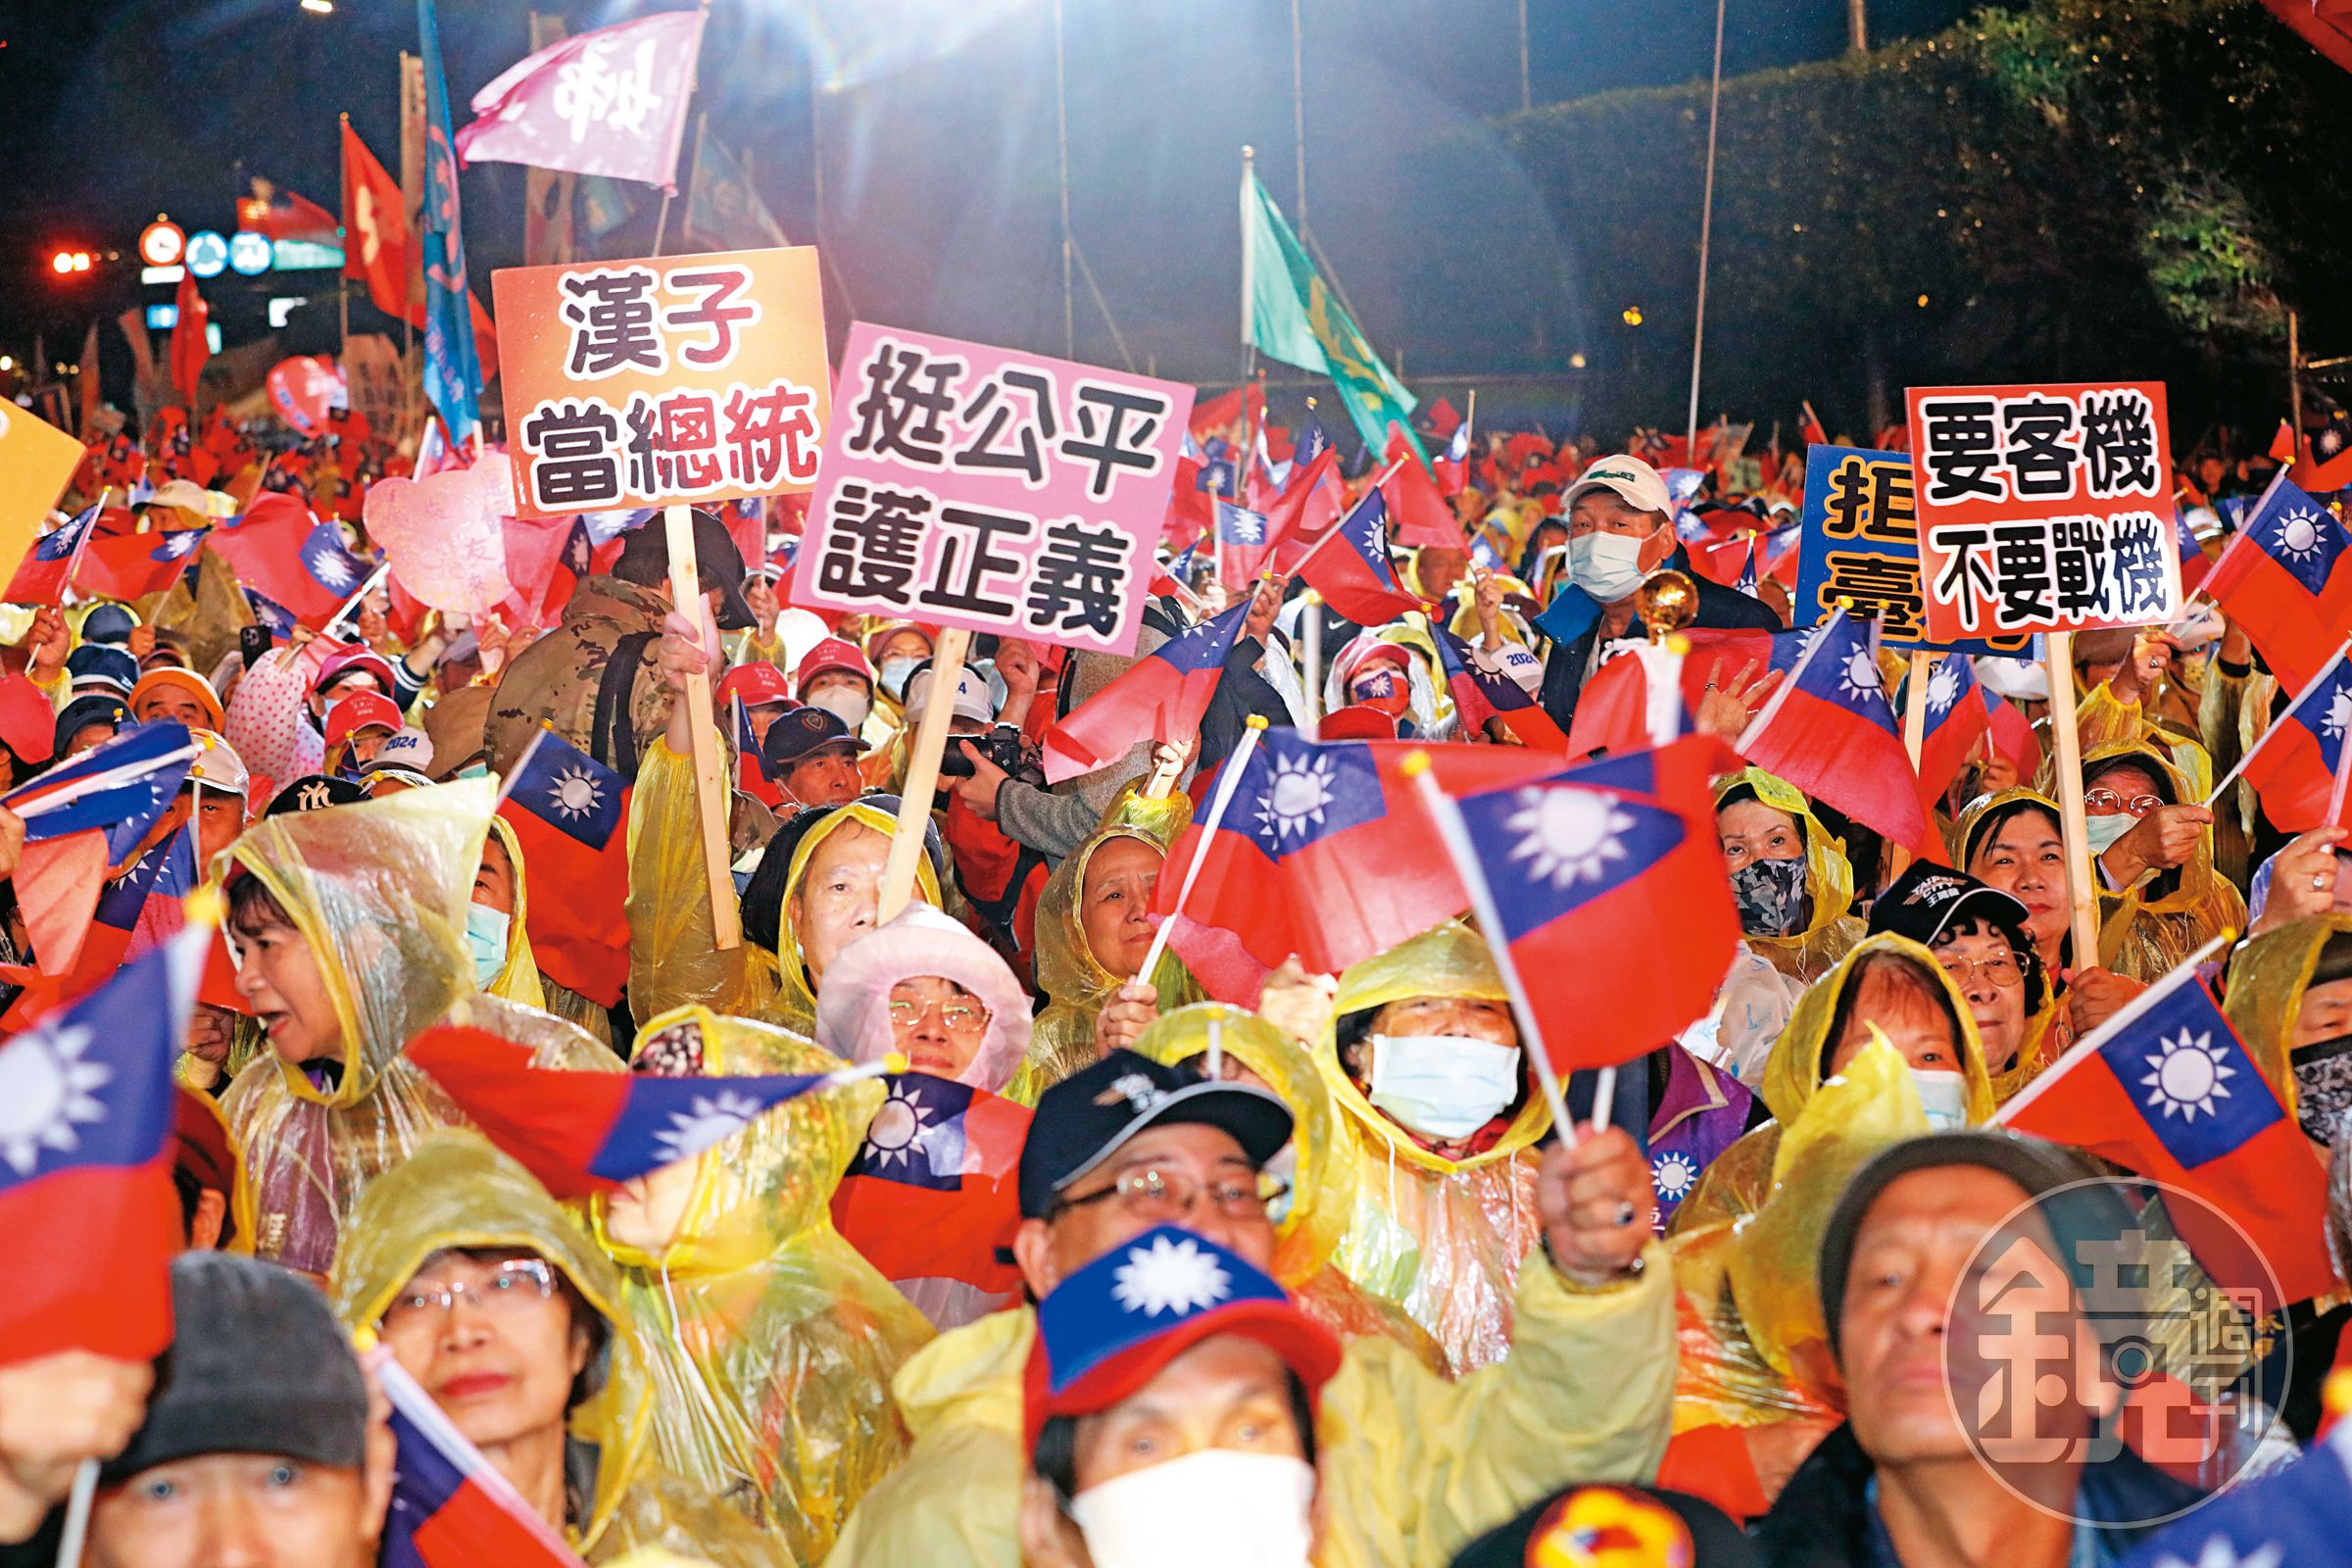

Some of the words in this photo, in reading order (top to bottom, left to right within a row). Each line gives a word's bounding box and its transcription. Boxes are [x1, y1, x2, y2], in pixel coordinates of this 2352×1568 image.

[564, 270, 754, 374] 漢子
[526, 385, 817, 506] 當總統
[849, 344, 1165, 496] 挺公平
[1925, 395, 2157, 501] 要客機
[1828, 461, 1918, 538] 拒
[819, 484, 1130, 637] 護正義
[1936, 516, 2168, 626] 不要戰機
[385, 737, 417, 751] 2024
